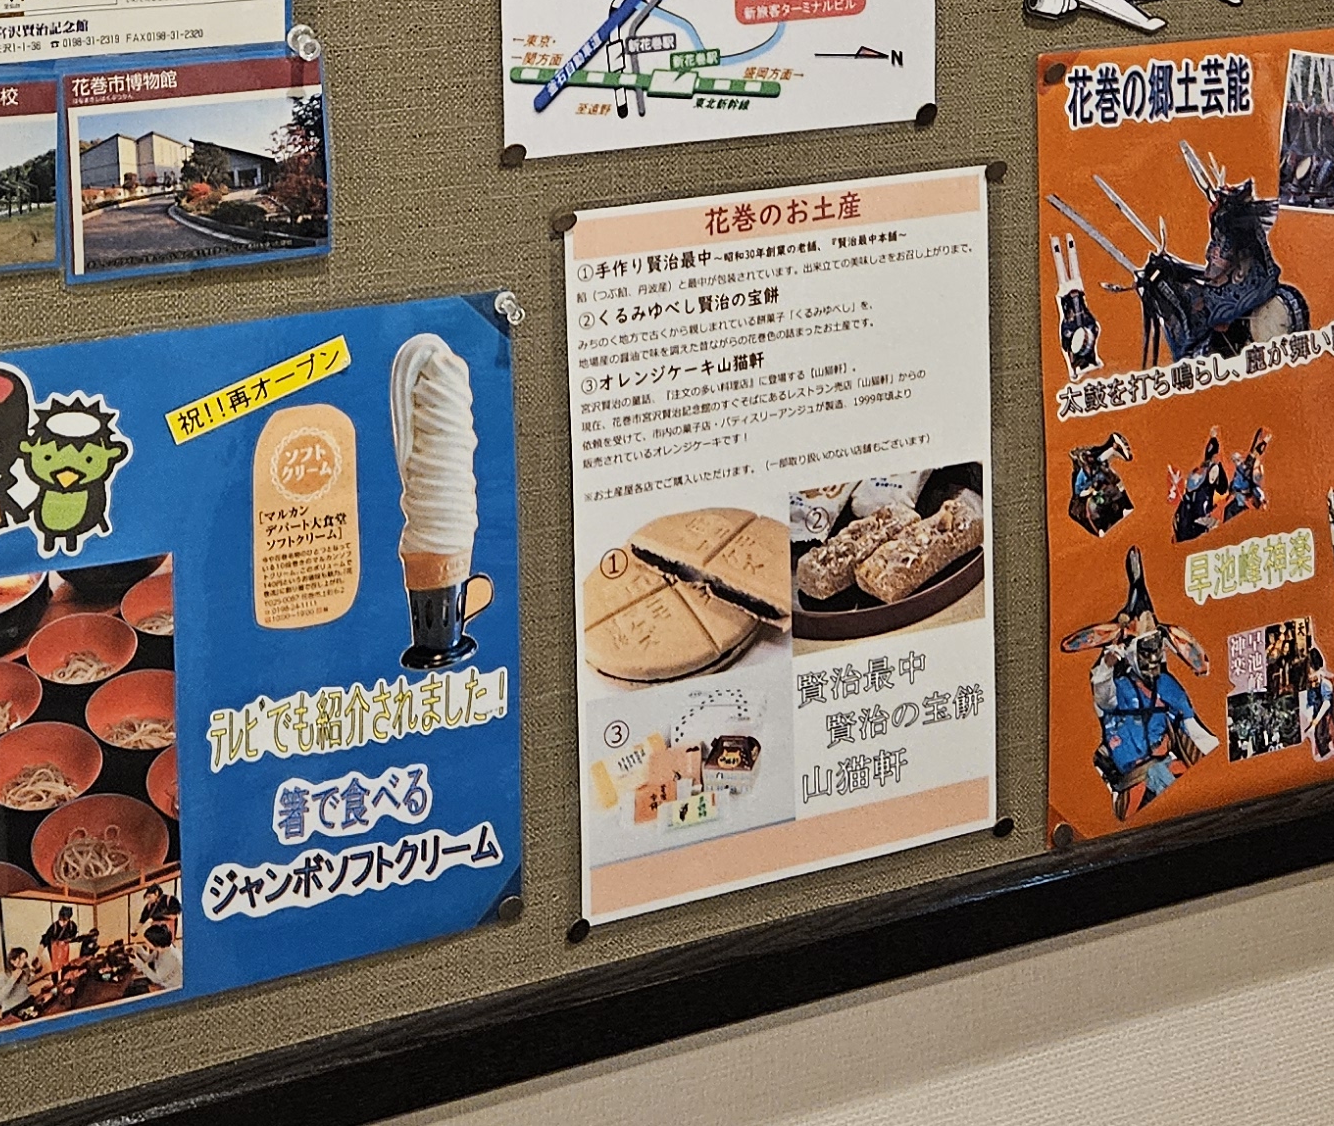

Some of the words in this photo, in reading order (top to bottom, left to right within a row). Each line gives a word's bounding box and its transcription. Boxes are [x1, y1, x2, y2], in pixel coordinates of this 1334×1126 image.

[511, 52, 563, 66] 一関方面
[628, 36, 675, 52] 新花巻駅
[672, 51, 718, 67] 新花巻駅
[891, 50, 903, 66] N
[547, 34, 601, 97] 釜石自動車道
[744, 67, 792, 80] 盛岡方面
[71, 70, 177, 97] 花巻市博物館
[1068, 56, 1252, 126] 花巻の郷土芸能
[575, 103, 611, 116] 至遠野
[694, 97, 750, 111] 東北新幹線
[705, 192, 862, 237] 花巻のお土産
[579, 286, 780, 330] ②くるみゆべし賢治の宝餅
[581, 351, 765, 395] ③オレンジケーキ山猫軒
[177, 349, 340, 435] 祝!!再オープン
[282, 462, 331, 483] クリーム
[286, 445, 326, 465] ソフト
[266, 513, 347, 536] デパート大食堂
[805, 507, 830, 533] ②
[600, 548, 628, 579] ①
[1188, 531, 1313, 601] 早池峰神楽
[1231, 636, 1246, 675] 神楽
[797, 650, 926, 708] 賢治最中
[211, 669, 505, 768] テレビでも紹介されました!
[826, 683, 984, 748] 賢治の宝餅
[604, 719, 630, 748] ③
[801, 747, 907, 803] 山猫軒
[278, 769, 428, 839] 箸で食べる
[210, 826, 499, 914] ジャンボソフトクリーム
